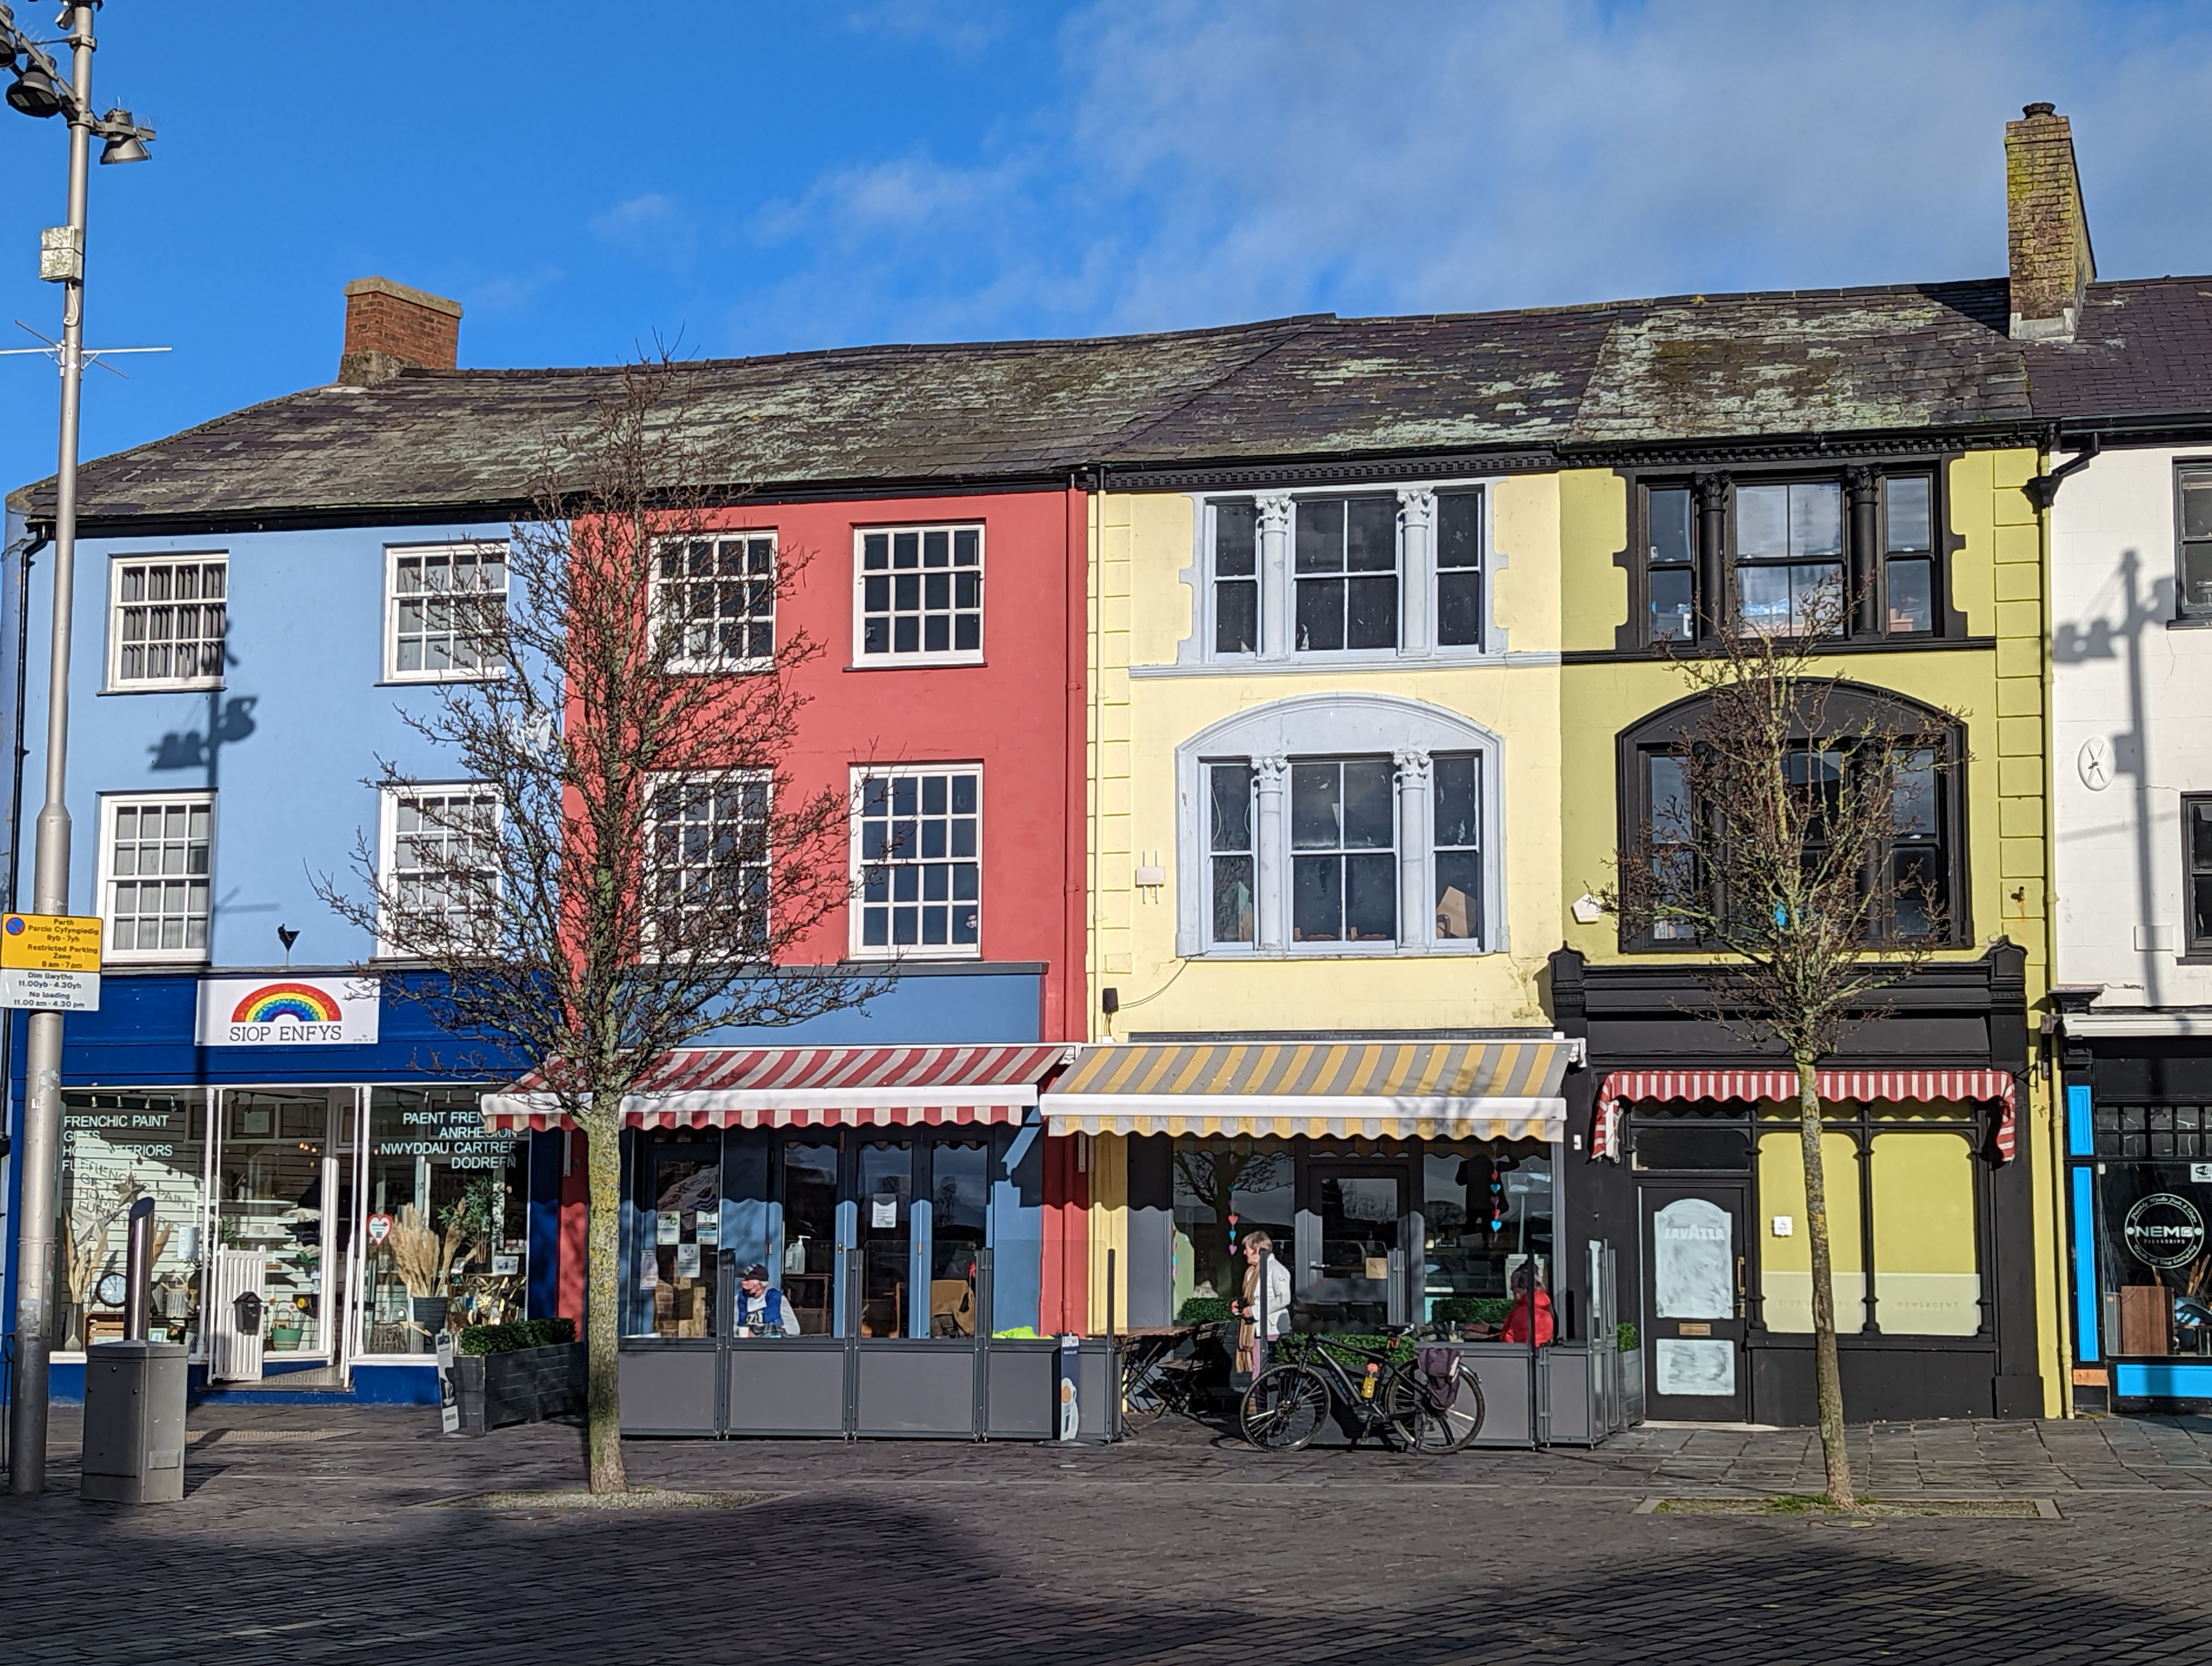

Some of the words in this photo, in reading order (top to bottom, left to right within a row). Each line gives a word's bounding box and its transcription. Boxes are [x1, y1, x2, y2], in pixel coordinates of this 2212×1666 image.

[54, 926, 99, 935] Cyfyngiedig
[27, 944, 66, 952] Restricted
[69, 946, 98, 954] Parking
[229, 1026, 271, 1041] SIOP
[279, 1025, 342, 1041] ENFYS
[64, 1114, 128, 1127] FRENCHIC
[132, 1114, 170, 1127] PAINT
[403, 1112, 446, 1125] PAENT
[451, 1111, 485, 1124] FREN
[63, 1130, 101, 1142] GITS
[381, 1142, 449, 1155] NWYDDAU
[454, 1141, 517, 1154] CARTREF
[451, 1157, 516, 1169] DODREFN
[1664, 1224, 1725, 1240] LAVAZZA
[2136, 1226, 2194, 1238] NEMO
